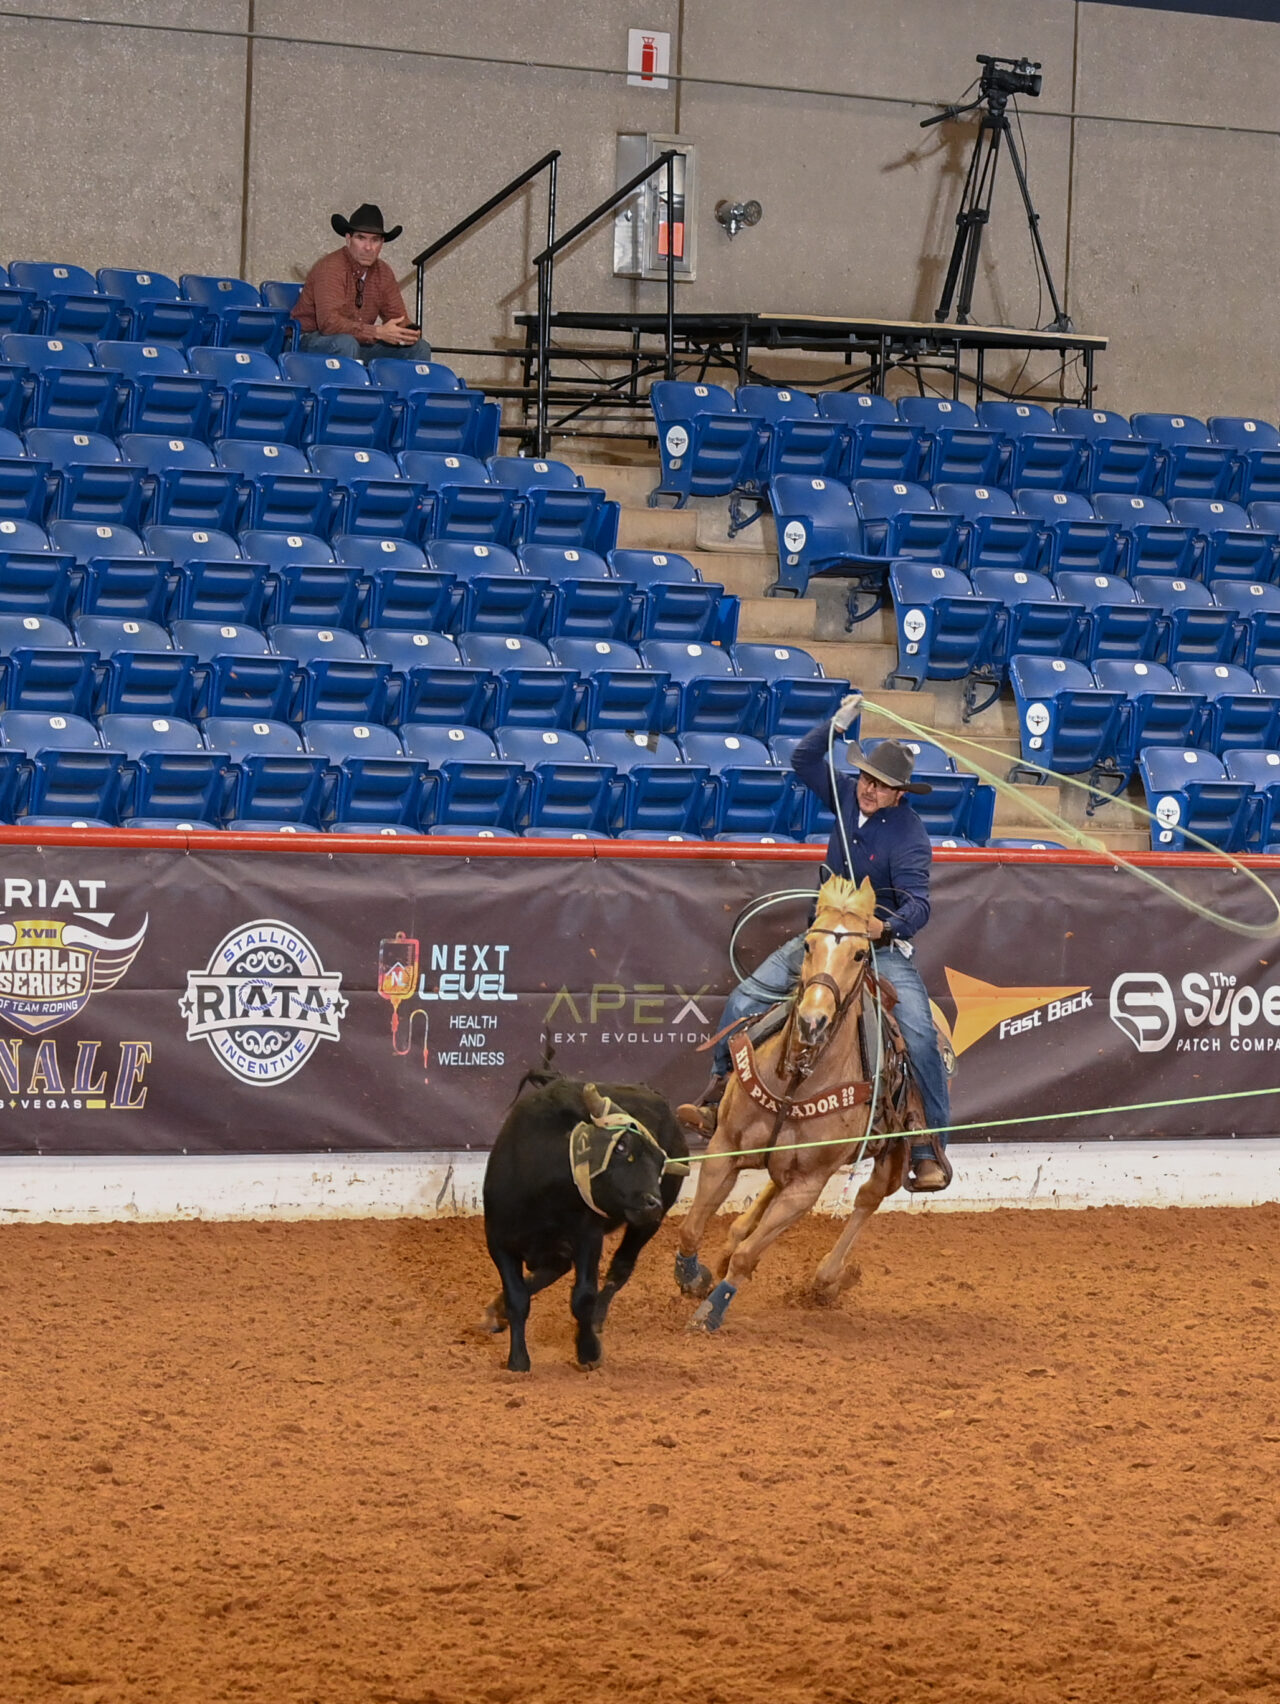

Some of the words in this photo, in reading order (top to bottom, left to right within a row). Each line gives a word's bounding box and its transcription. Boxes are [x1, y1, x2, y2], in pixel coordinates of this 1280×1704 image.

[21, 928, 57, 938] XVIII
[224, 931, 308, 963] STALLION
[431, 944, 510, 970] NEXT
[1210, 971, 1237, 987] The
[418, 974, 518, 1001] LEVEL
[13, 1001, 40, 1012] TEAM
[42, 1000, 78, 1013] ROPING
[195, 984, 332, 1025] RIATA
[542, 984, 711, 1024] APEX
[450, 1016, 498, 1029] HEALTH
[999, 1010, 1042, 1040] Fast
[1047, 990, 1093, 1022] Back
[459, 1034, 486, 1047] AND
[601, 1033, 711, 1043] EVOLUTION
[1177, 1038, 1222, 1052] PATCH
[221, 1039, 306, 1075] INCENTIVE
[438, 1052, 505, 1066] WELLNESS
[736, 1045, 752, 1083] HPW
[21, 1100, 82, 1109] VEGAS
